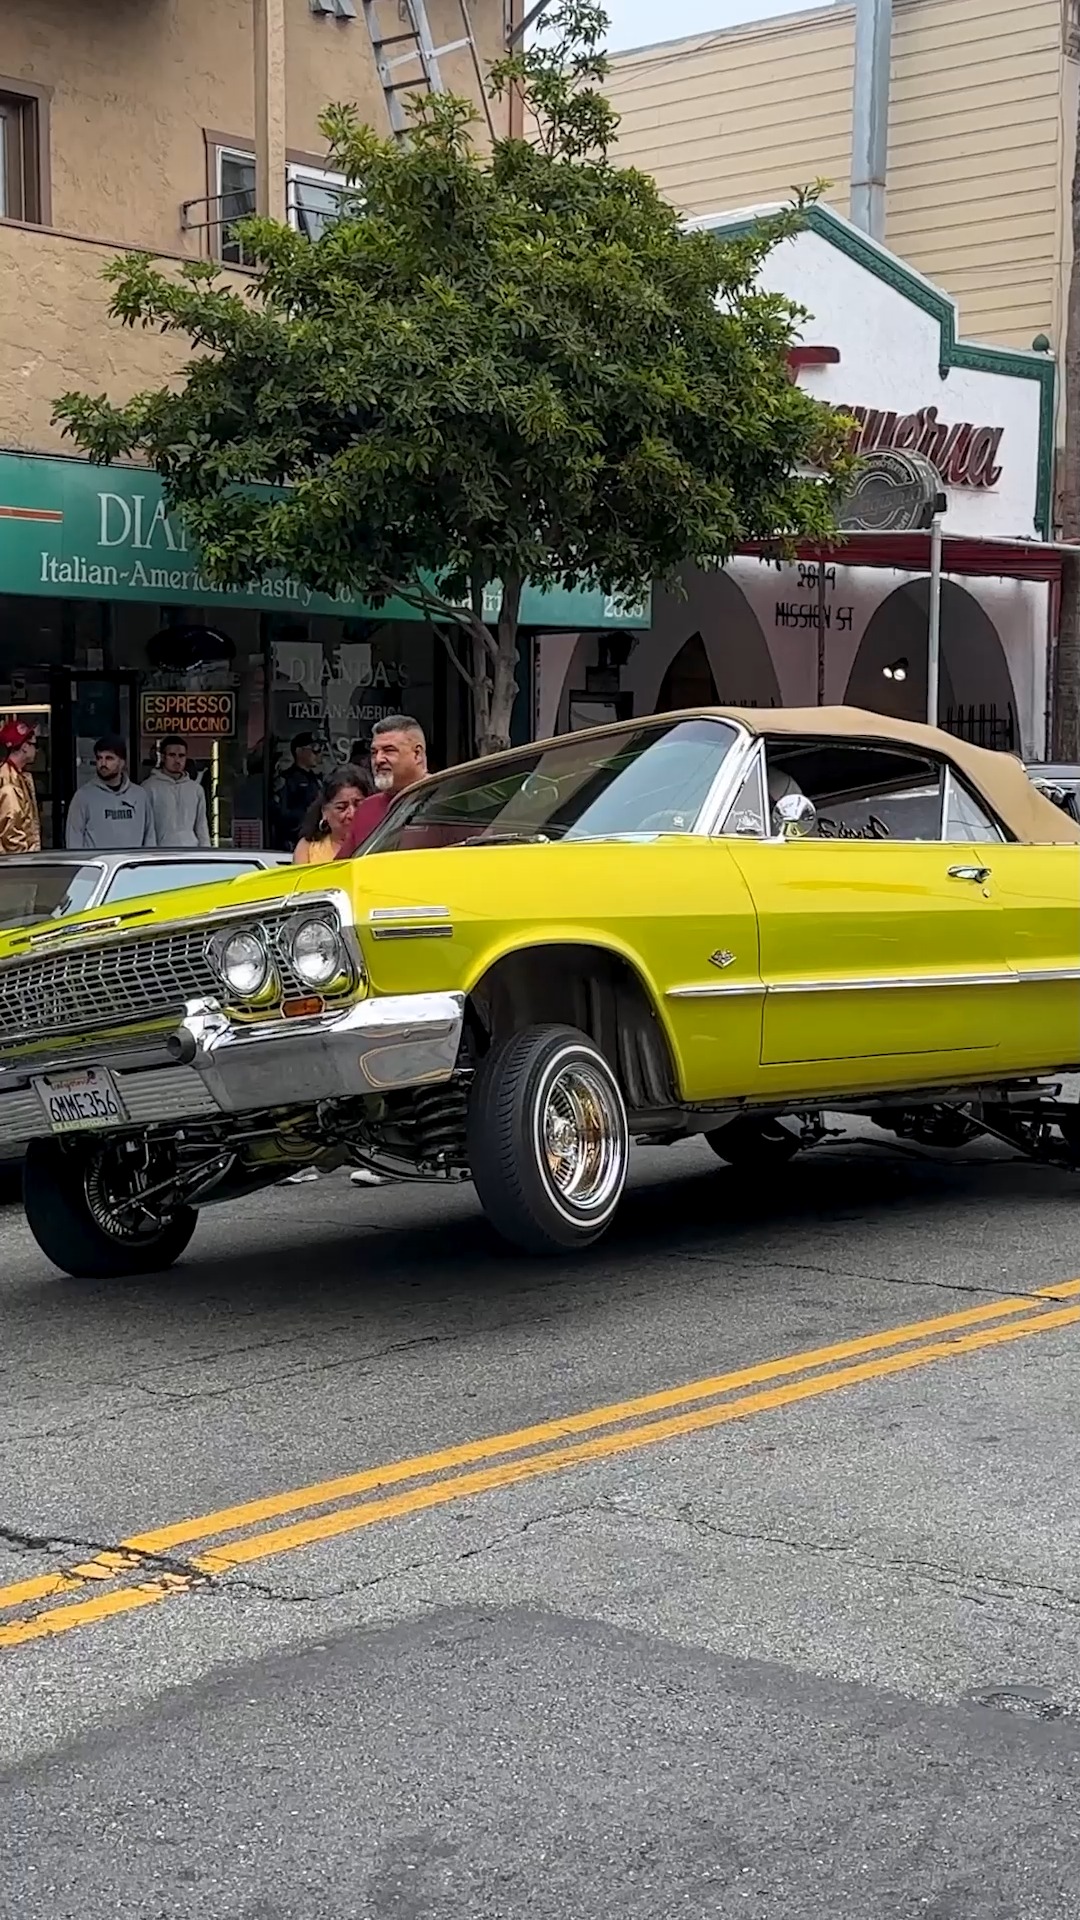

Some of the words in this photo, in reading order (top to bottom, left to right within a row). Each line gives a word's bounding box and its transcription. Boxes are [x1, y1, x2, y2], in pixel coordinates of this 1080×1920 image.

[797, 563, 836, 590] 289
[836, 607, 855, 631] ST
[144, 695, 232, 714] ESPRESSO
[145, 716, 230, 732] CAPPUCCINO
[105, 809, 133, 820] PUMA
[50, 1089, 118, 1122] 6MME356
